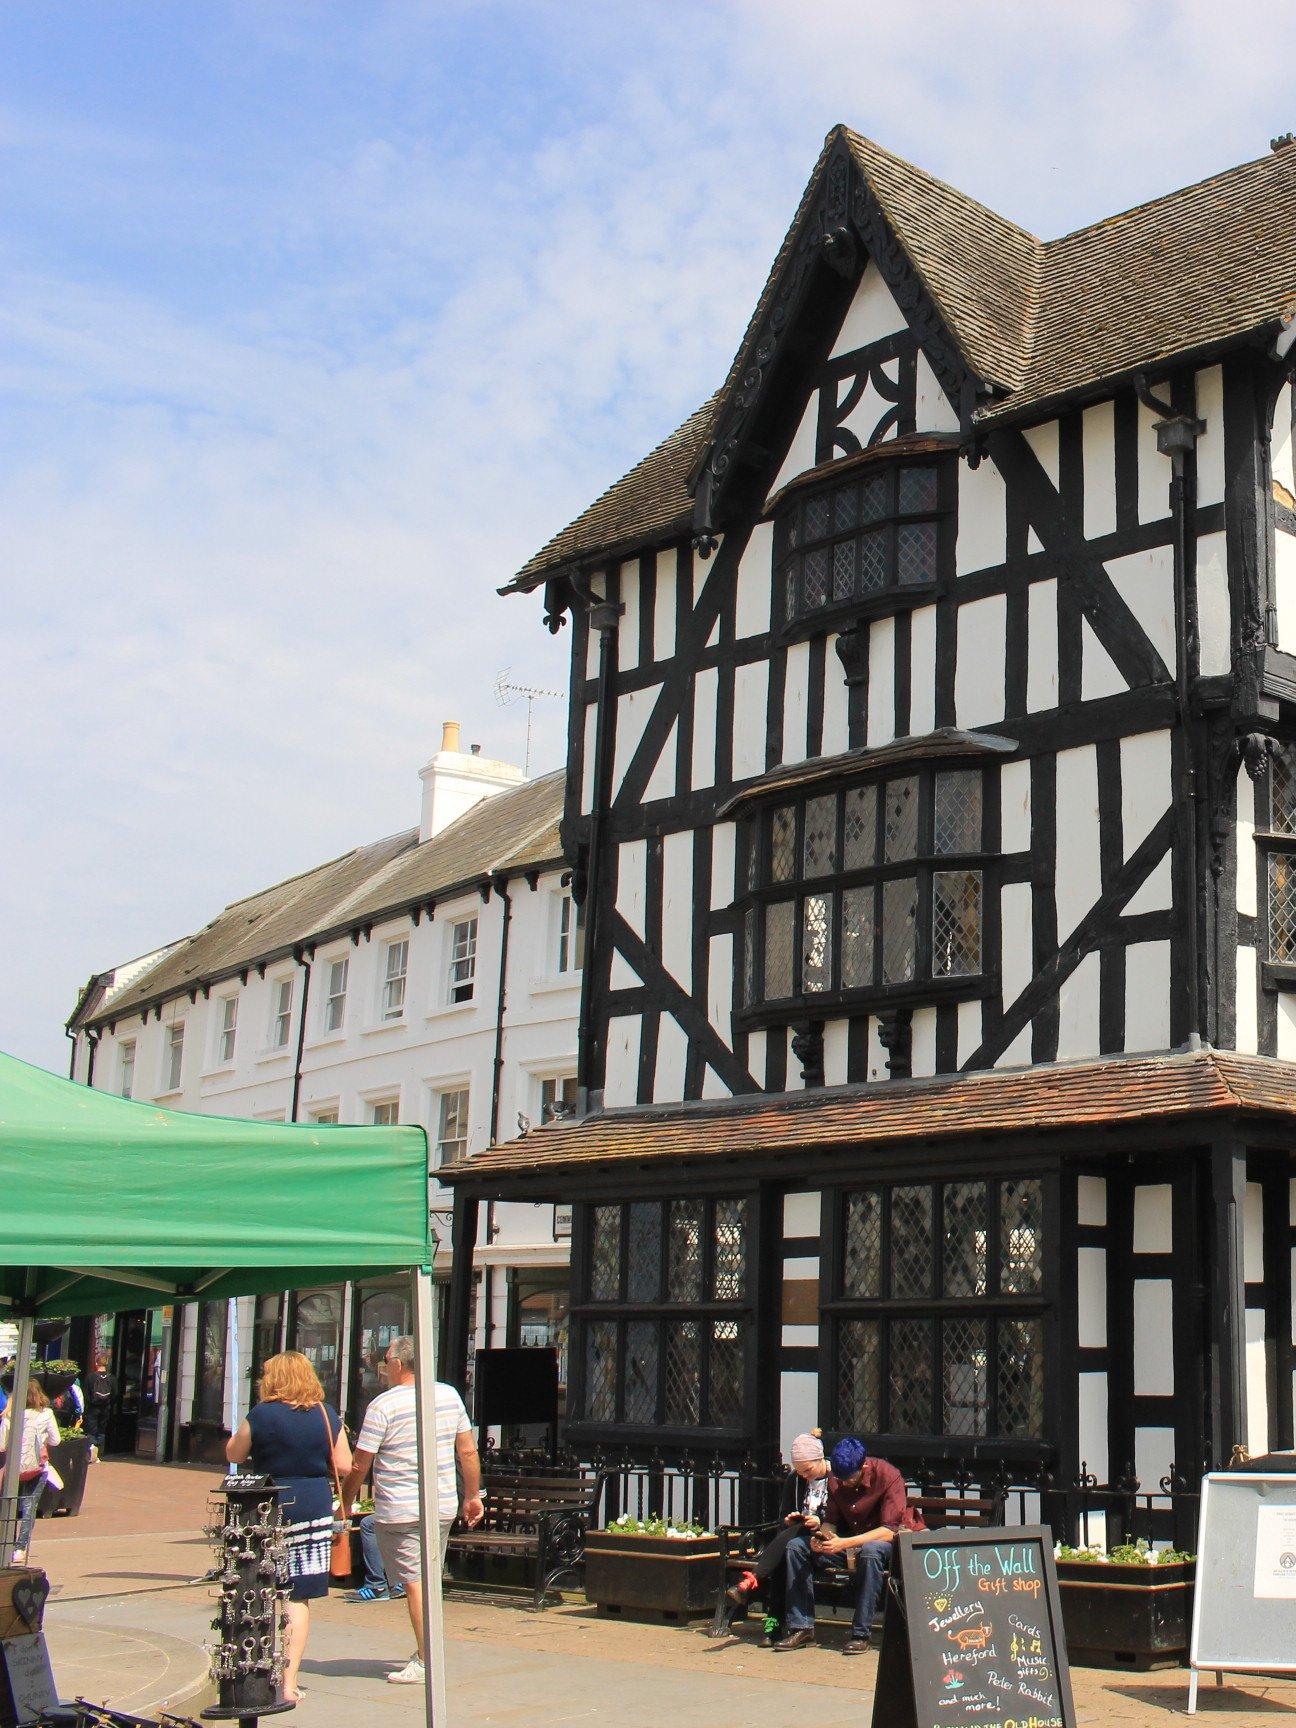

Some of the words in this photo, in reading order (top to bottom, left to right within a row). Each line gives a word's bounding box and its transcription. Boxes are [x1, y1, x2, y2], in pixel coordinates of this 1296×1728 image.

[923, 1548, 961, 1592] Off
[967, 1553, 992, 1577] the
[994, 1546, 1036, 1577] Wall
[978, 1577, 1009, 1596] Gift
[1012, 1577, 1041, 1600] shop
[928, 1600, 985, 1633] Jewellery
[1008, 1613, 1041, 1639] Cards
[942, 1643, 998, 1667] Hereford
[1016, 1655, 1048, 1668] Music
[1017, 1668, 1039, 1679] gifts
[938, 1694, 958, 1706] and
[961, 1692, 987, 1702] much
[986, 1670, 1013, 1691] Peter
[1017, 1682, 1054, 1707] Rabbit
[965, 1696, 1001, 1712] more!
